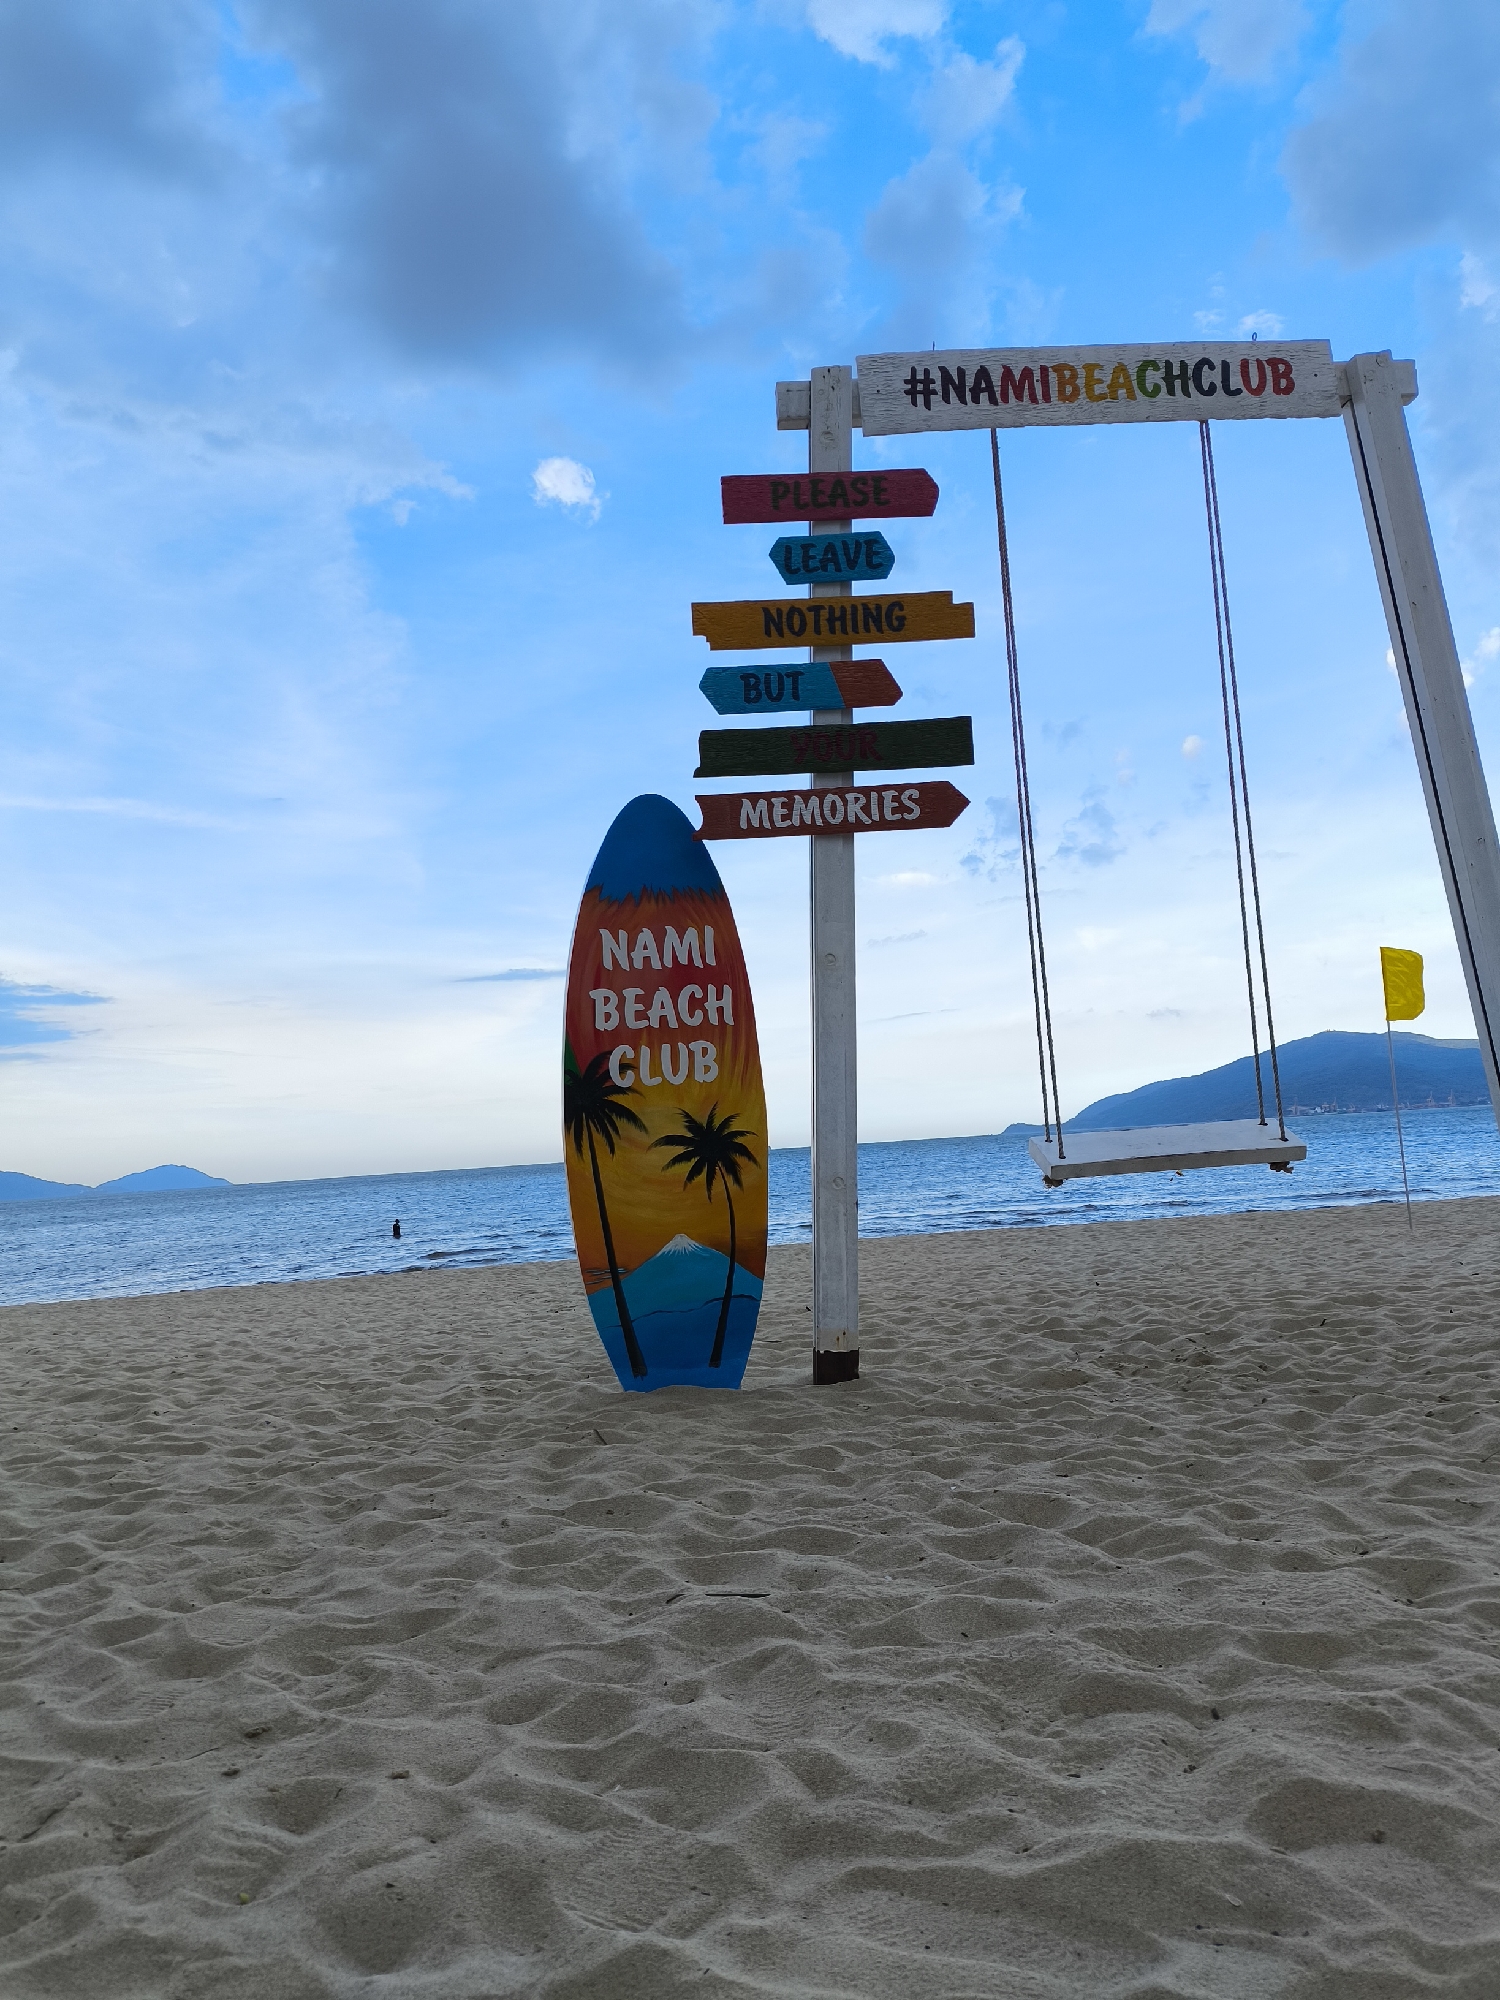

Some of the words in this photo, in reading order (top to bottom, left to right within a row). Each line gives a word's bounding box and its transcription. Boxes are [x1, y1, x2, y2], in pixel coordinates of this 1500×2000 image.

[904, 356, 1296, 410] #NAMIBEACHCLUB
[771, 474, 890, 511] PLEASE
[783, 536, 885, 574] LEAVE
[763, 601, 907, 638] NOTHING
[740, 671, 805, 704] BUT
[790, 730, 884, 764] YOUR
[739, 788, 921, 830] MEMORIES
[599, 925, 717, 970] NAMI
[589, 983, 735, 1031] BEACH
[608, 1040, 719, 1088] CLUB
